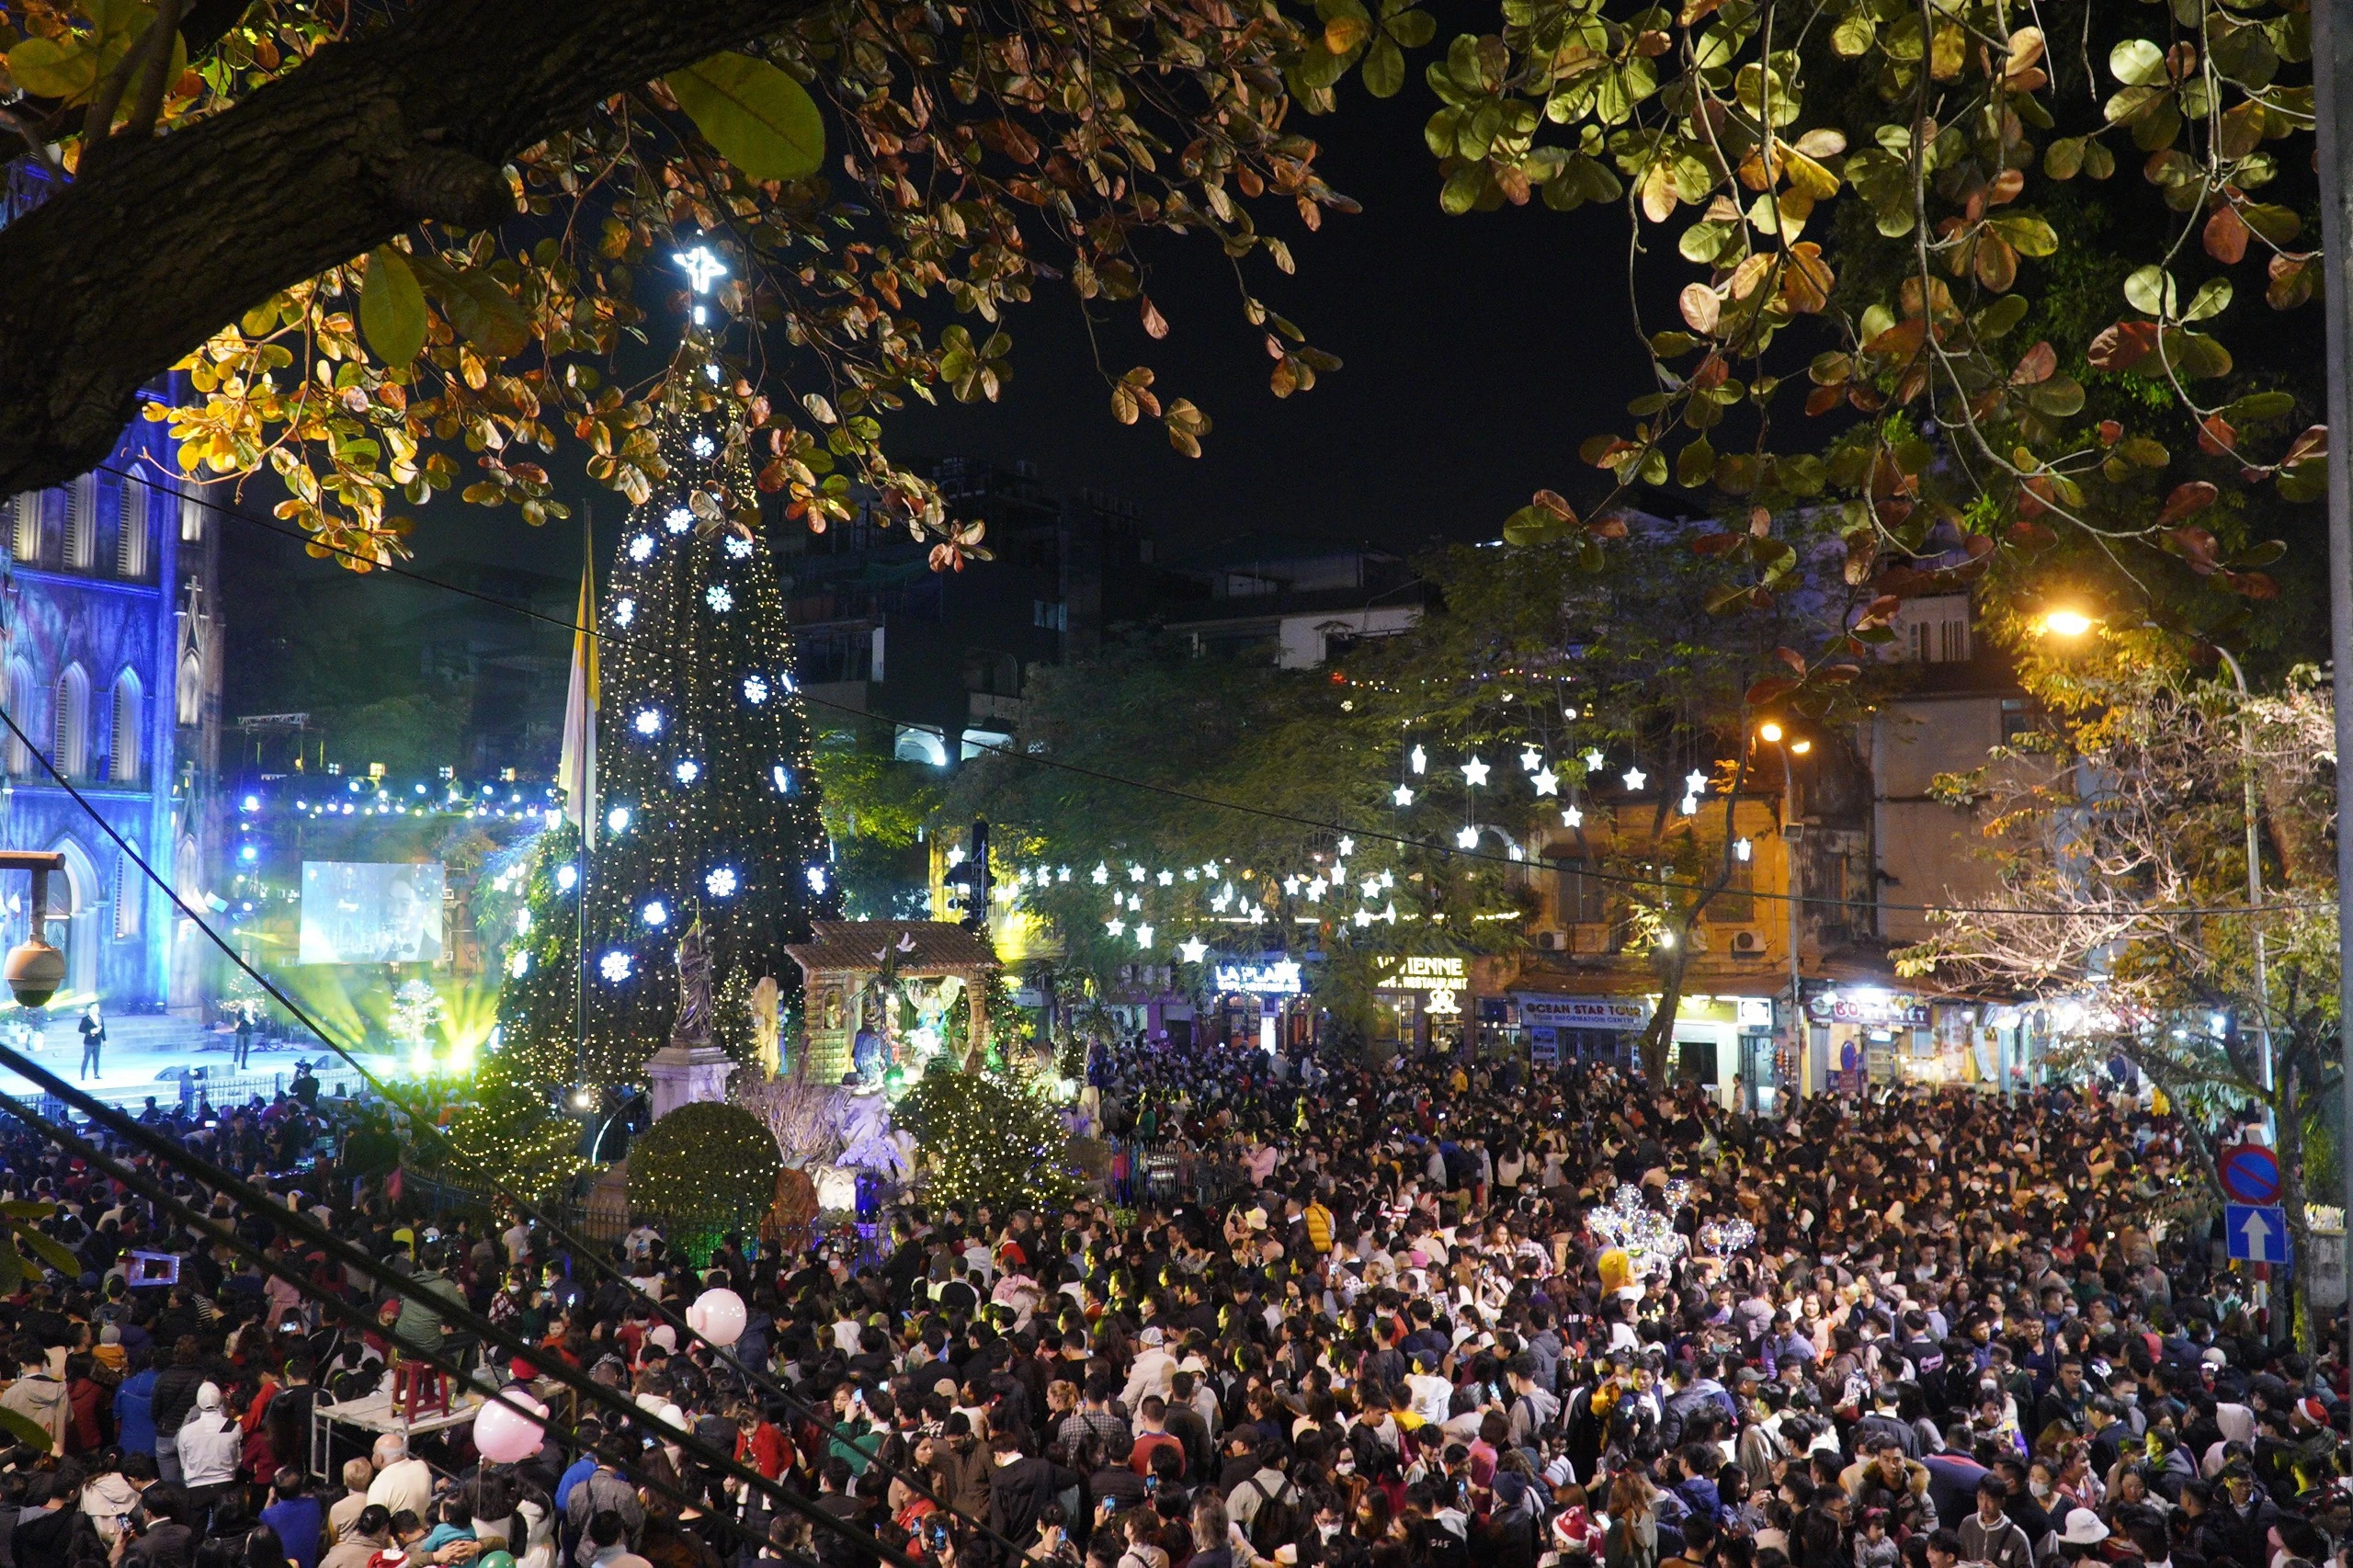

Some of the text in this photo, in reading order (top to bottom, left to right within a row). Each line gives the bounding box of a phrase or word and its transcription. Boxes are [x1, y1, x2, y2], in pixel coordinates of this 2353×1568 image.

[1403, 976, 1469, 990] RESTAURANT
[1527, 1003, 1641, 1017] OCEAN STAR TOUR
